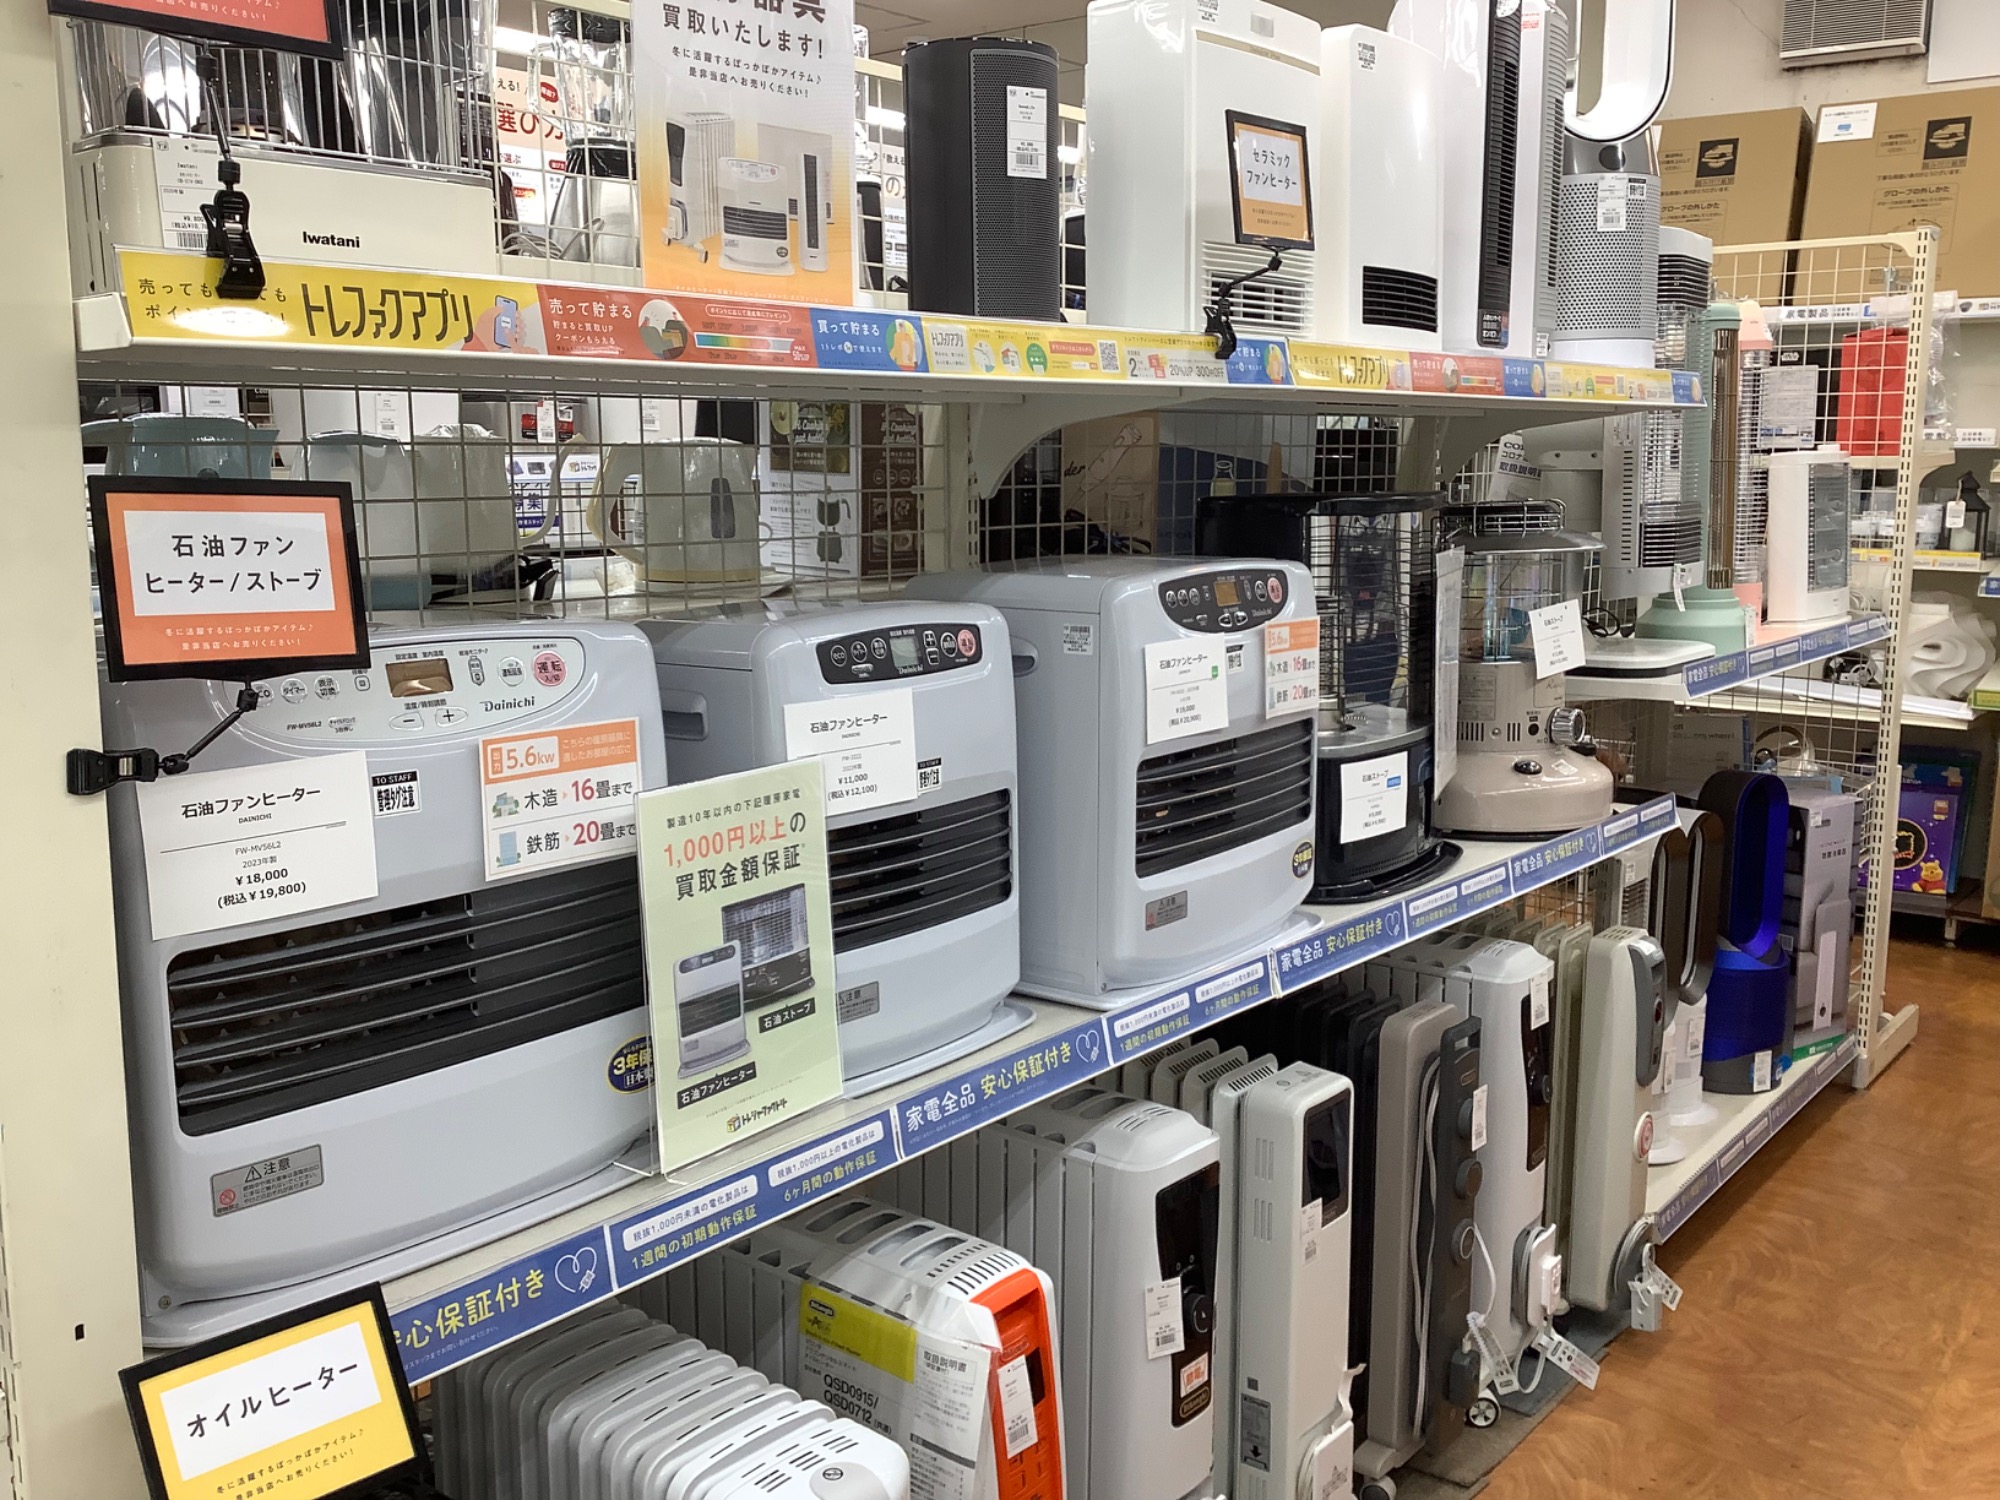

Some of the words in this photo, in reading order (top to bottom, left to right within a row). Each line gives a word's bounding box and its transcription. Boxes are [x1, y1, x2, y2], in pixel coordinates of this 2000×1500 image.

[662, 3, 823, 60] 買取いたします!
[1253, 148, 1290, 168] セラミック
[1247, 170, 1298, 190] ファンヒーター
[303, 231, 360, 249] Iwatani
[549, 298, 632, 319] 売って貯まる
[817, 319, 880, 337] 買って貯まる
[171, 534, 294, 558] 石油ファン
[145, 568, 322, 594] ヒーター/ストーブ
[537, 660, 562, 673] 運転
[479, 696, 535, 713] Dainichi
[810, 713, 888, 734] 石油ファンヒーター
[376, 777, 388, 785] TO
[389, 773, 413, 784] STAFF
[571, 778, 633, 803] 16畳まで
[181, 786, 322, 820] 石油ファンヒーター
[524, 787, 559, 811] 木造
[238, 812, 273, 825] DAINICHI
[526, 832, 561, 856] 鉄筋
[573, 820, 637, 847] 20畳まで
[663, 811, 807, 868] 1,000円以上の
[234, 840, 282, 857] FW-MV56L2
[242, 855, 278, 869] 2023年製
[675, 845, 801, 902] 買取金額保証
[235, 867, 289, 887] ¥18,000
[217, 881, 307, 910] (税込¥19,800)
[1281, 940, 1323, 973] 家電全品
[1326, 917, 1383, 956] 安心保証付き
[763, 1002, 812, 1030] 石油ストーブ
[680, 1069, 755, 1105] 石油ファンヒーター
[906, 1082, 976, 1133] 家電全品
[980, 1041, 1072, 1100] 安心保証付き
[263, 1156, 291, 1176] 注意
[777, 1129, 875, 1180] 税抜1,000円以上の電化製品は
[633, 1185, 749, 1241] 税抜1,000円未満の電化製品は
[631, 1203, 758, 1270] 1週間の初期動作保証
[393, 1267, 545, 1349] 心保証付き
[923, 1350, 967, 1373] 取扱説明書
[187, 1363, 358, 1439] オイルヒーター
[823, 1373, 879, 1410] QSD0915/
[823, 1389, 872, 1424] QSD0712
